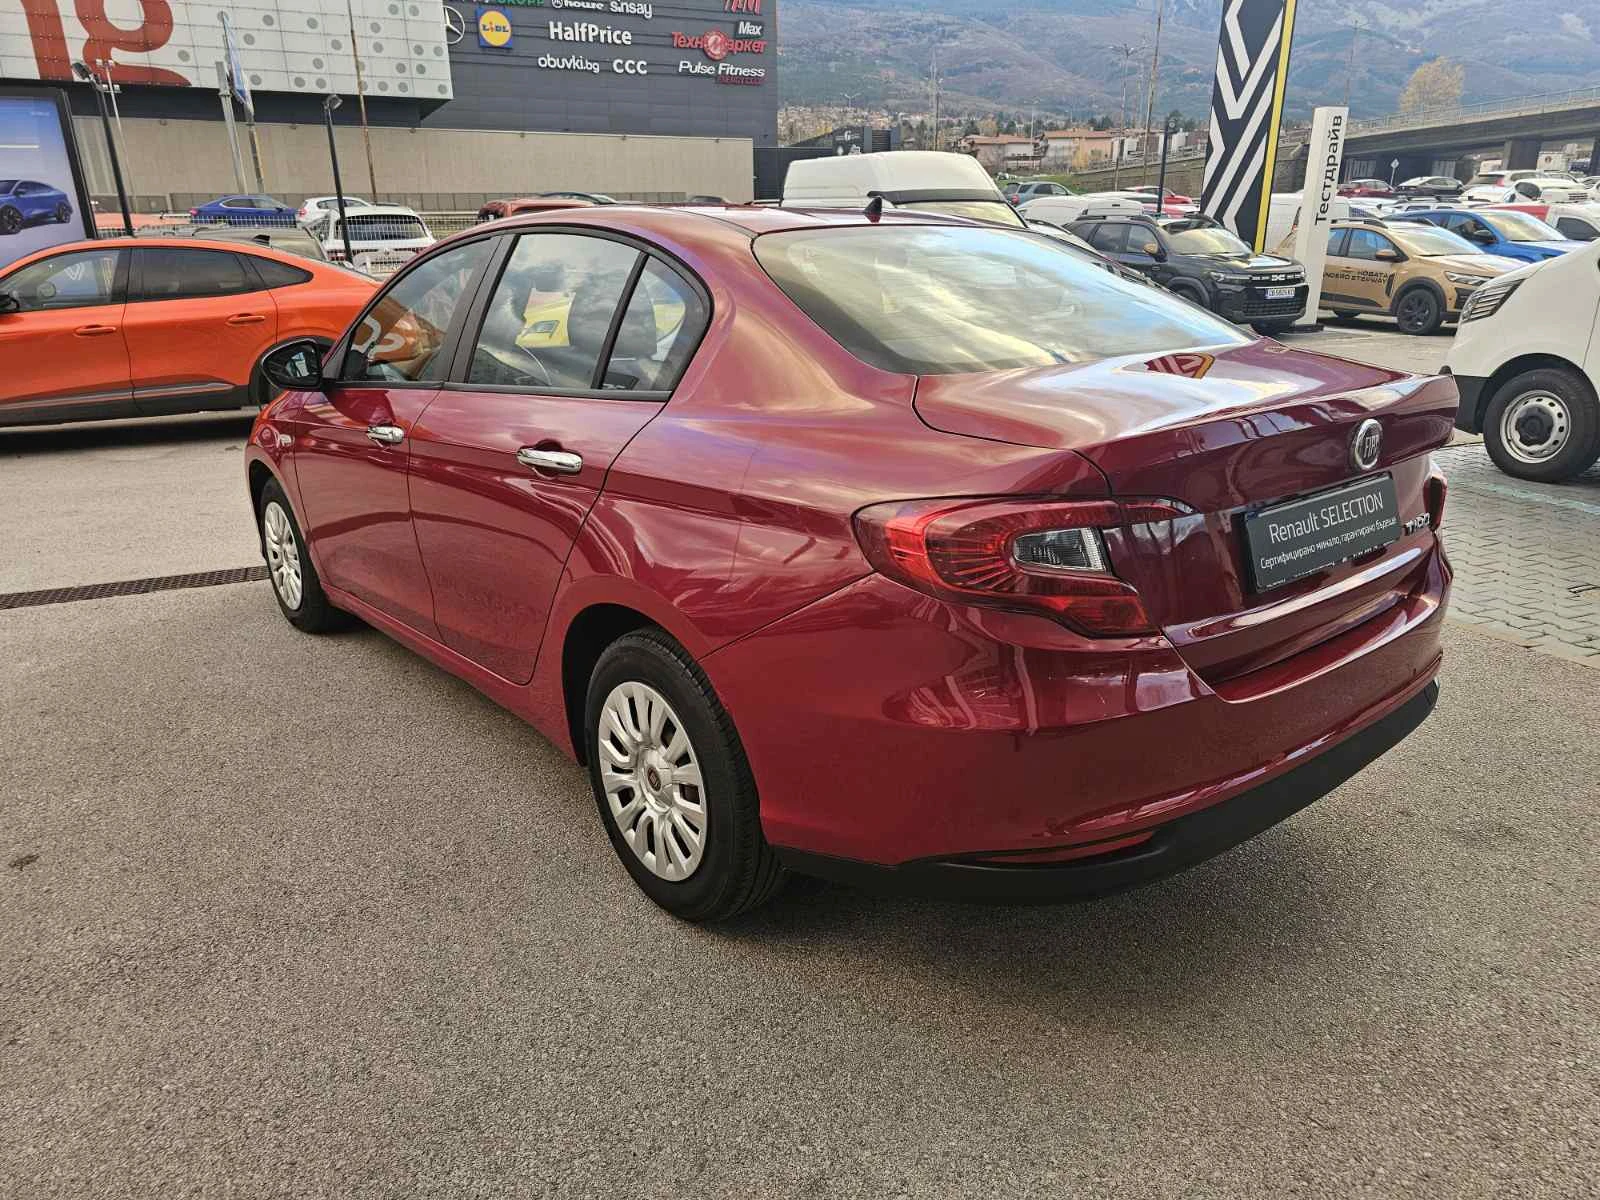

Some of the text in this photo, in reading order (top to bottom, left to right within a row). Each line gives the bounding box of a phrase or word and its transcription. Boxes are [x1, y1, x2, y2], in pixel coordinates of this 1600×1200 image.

[549, 21, 632, 45] HalfPrice
[738, 21, 762, 36] Max
[538, 53, 600, 74] obuvki.bg
[678, 60, 766, 78] Pulse Fitness
[1314, 114, 1343, 226] Тестдрайв
[1269, 492, 1384, 544] Renault SELECTION
